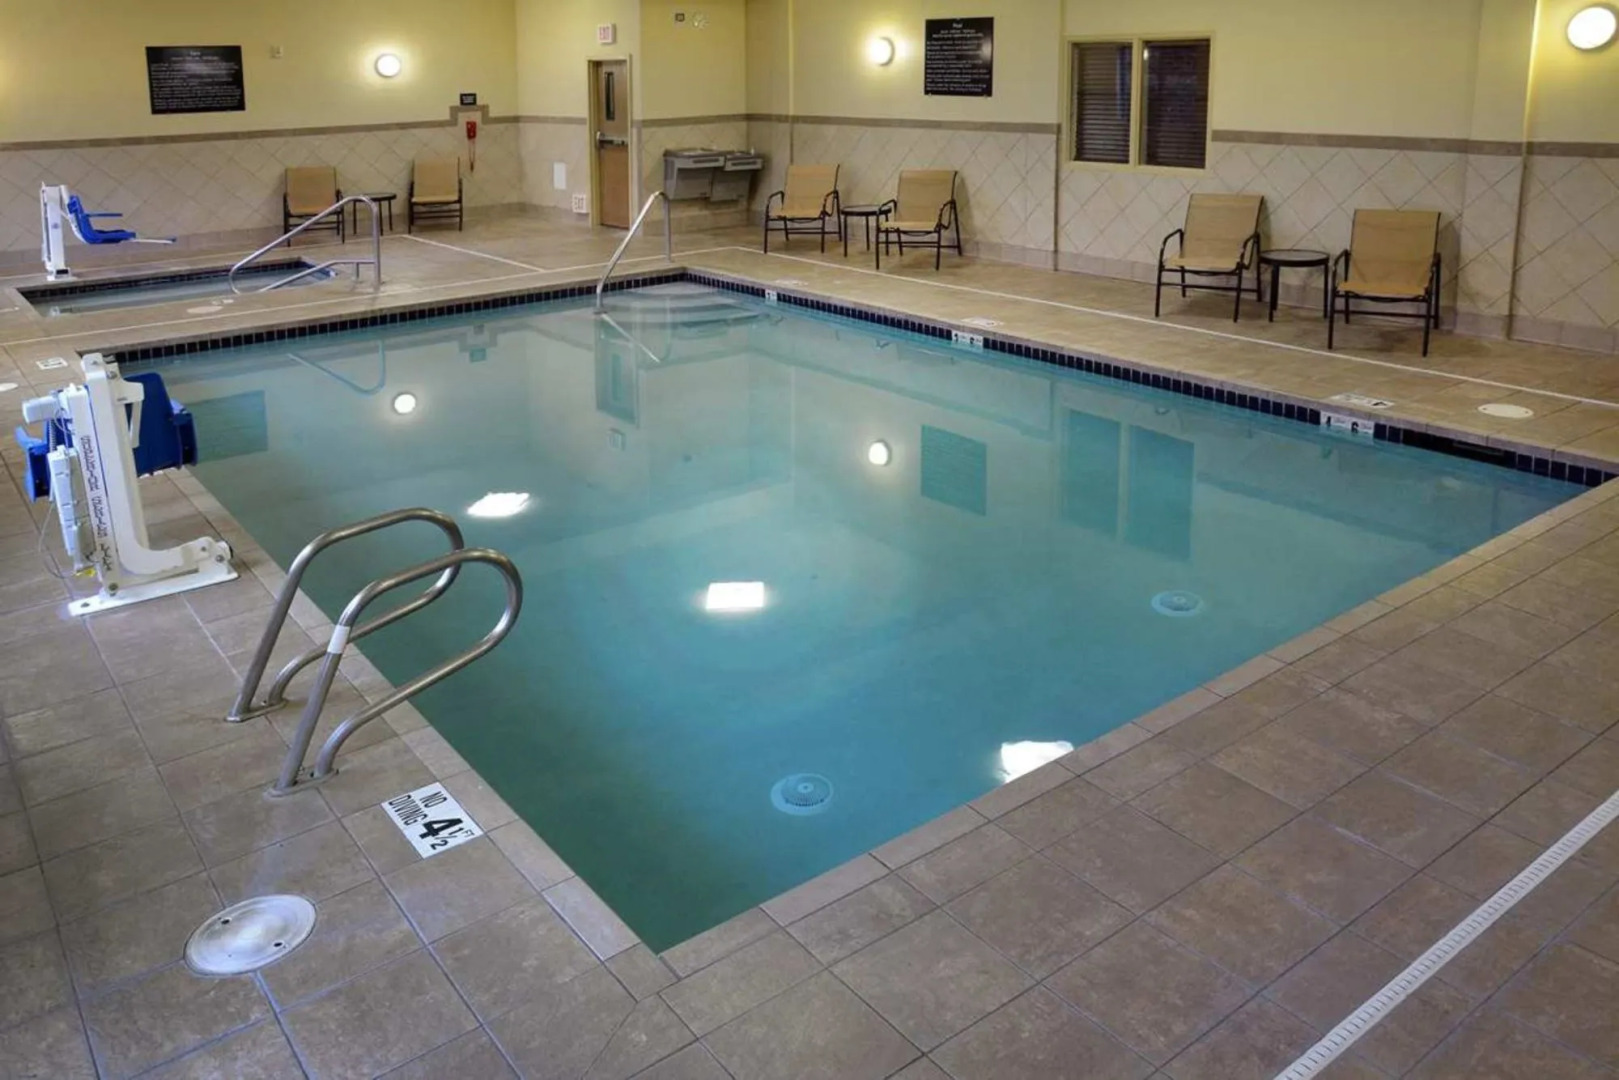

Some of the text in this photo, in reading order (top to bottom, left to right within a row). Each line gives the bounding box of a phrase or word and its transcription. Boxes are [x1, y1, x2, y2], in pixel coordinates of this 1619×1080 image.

[419, 790, 448, 808] NO
[388, 794, 428, 827] DIVING
[461, 829, 475, 838] FT
